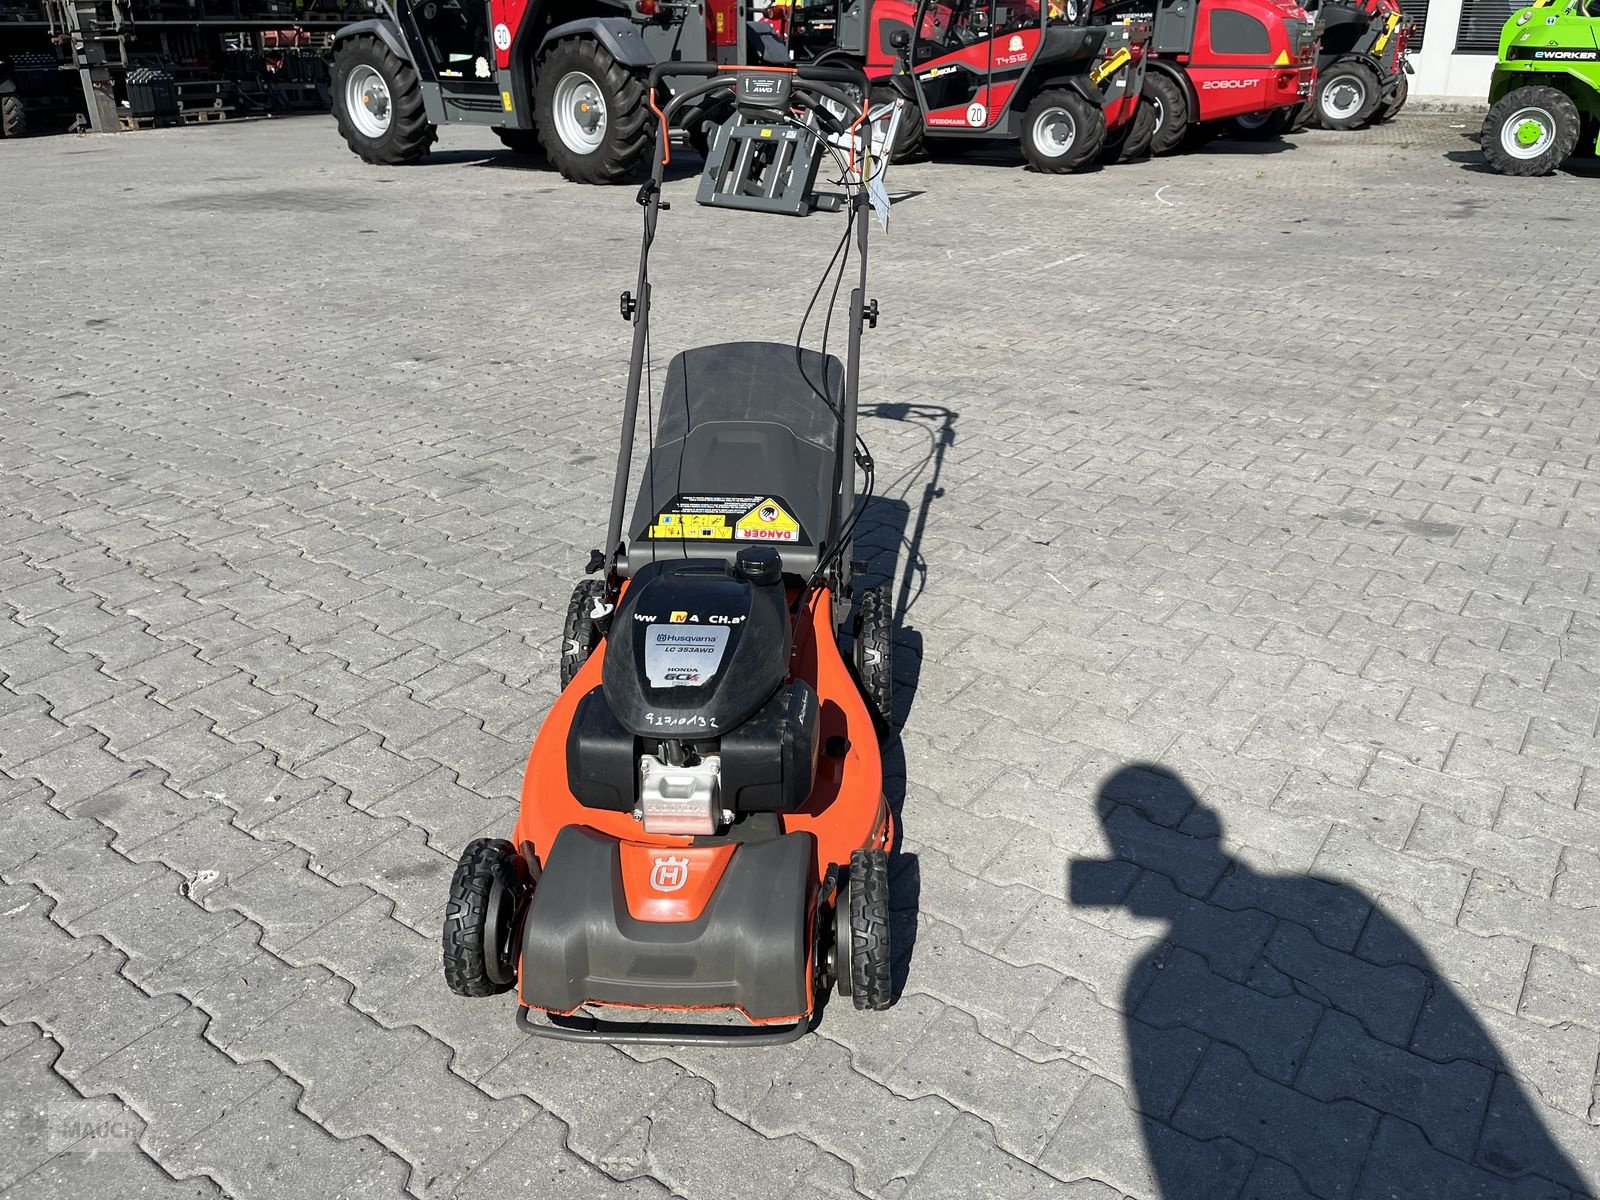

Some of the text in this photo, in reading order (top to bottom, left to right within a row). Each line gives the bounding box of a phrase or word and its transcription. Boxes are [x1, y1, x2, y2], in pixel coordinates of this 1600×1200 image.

[497, 29, 507, 45] 30
[1535, 51, 1597, 60] eWORKER
[1202, 79, 1260, 90] 2080LPT
[971, 108, 982, 122] 20
[744, 529, 791, 539] DANGER
[667, 634, 716, 642] Husqvarna
